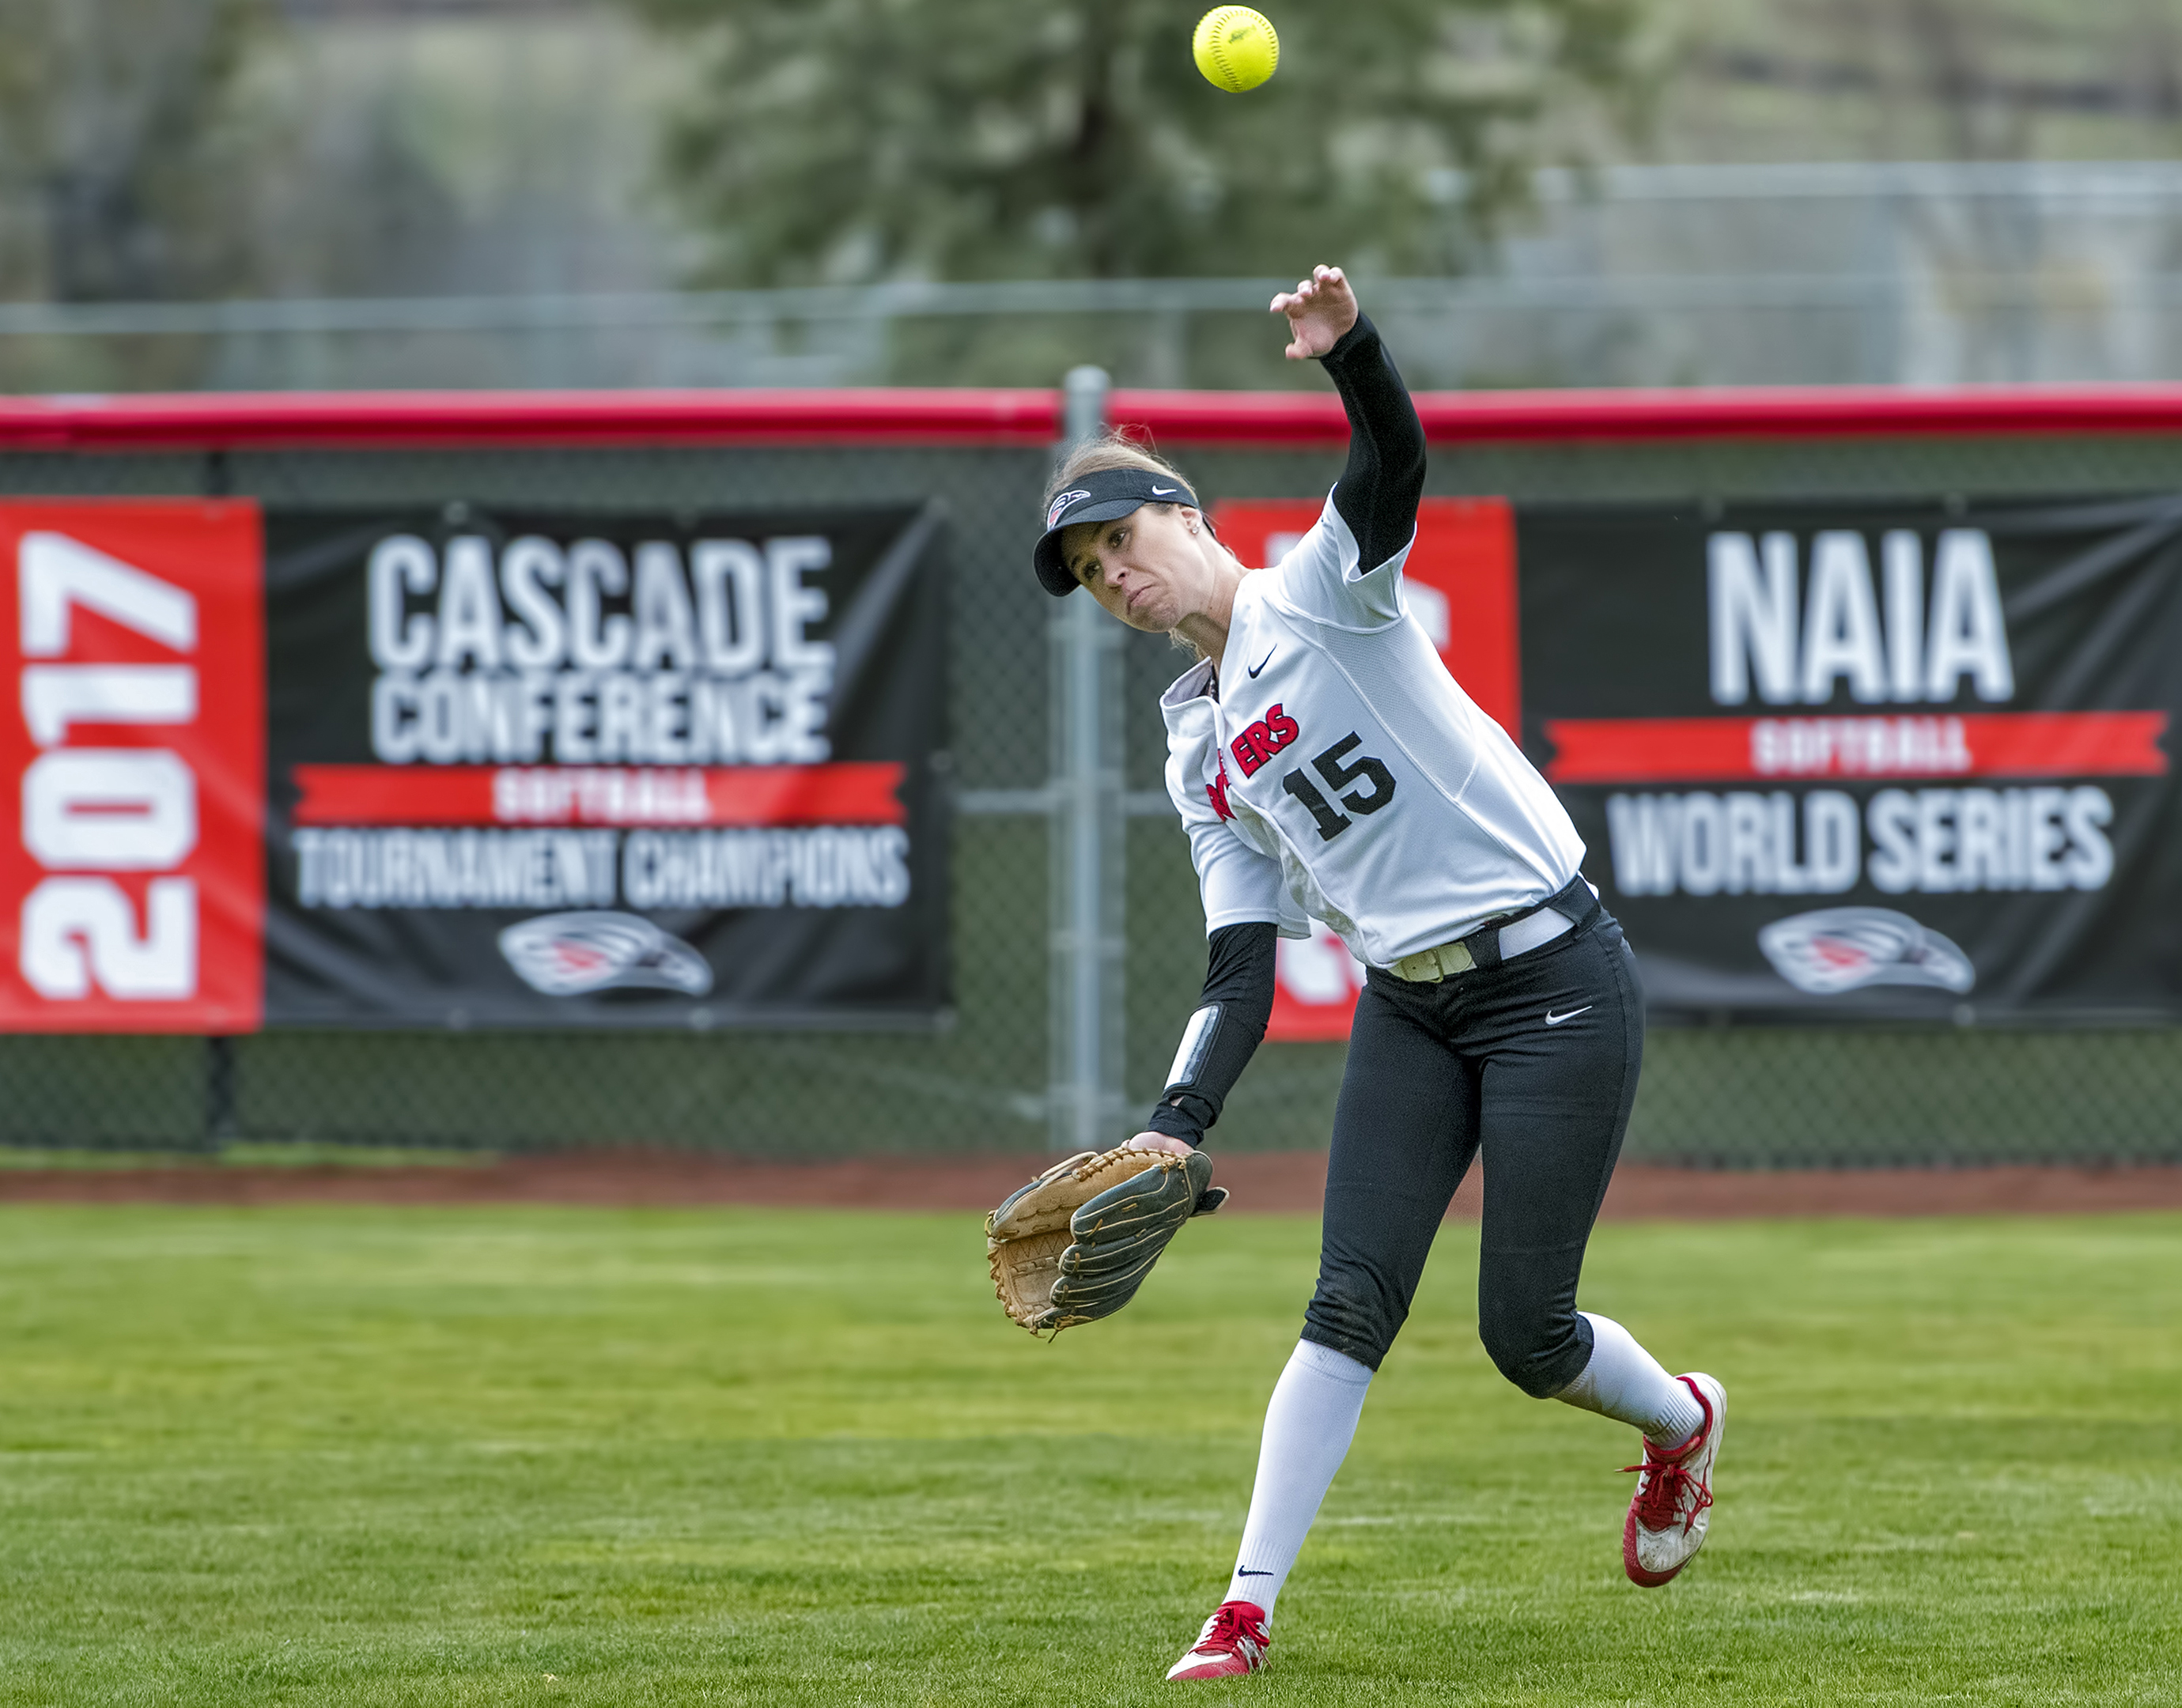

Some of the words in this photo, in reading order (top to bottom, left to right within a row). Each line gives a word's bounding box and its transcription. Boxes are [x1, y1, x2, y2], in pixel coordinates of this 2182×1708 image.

[369, 535, 834, 675] CASCADE
[1707, 529, 2014, 704] NAIA
[19, 531, 198, 1001] 2017
[371, 670, 831, 765] CONFERENCE
[1751, 715, 1972, 776] SOFTBALL
[493, 767, 710, 824] SOFTBALL
[1281, 730, 1397, 842] 15
[1606, 791, 1862, 896] WORLD
[1866, 785, 2114, 893] SERIES
[293, 827, 620, 909] TOURNAMENT
[622, 825, 911, 909] CHAMPIONS
